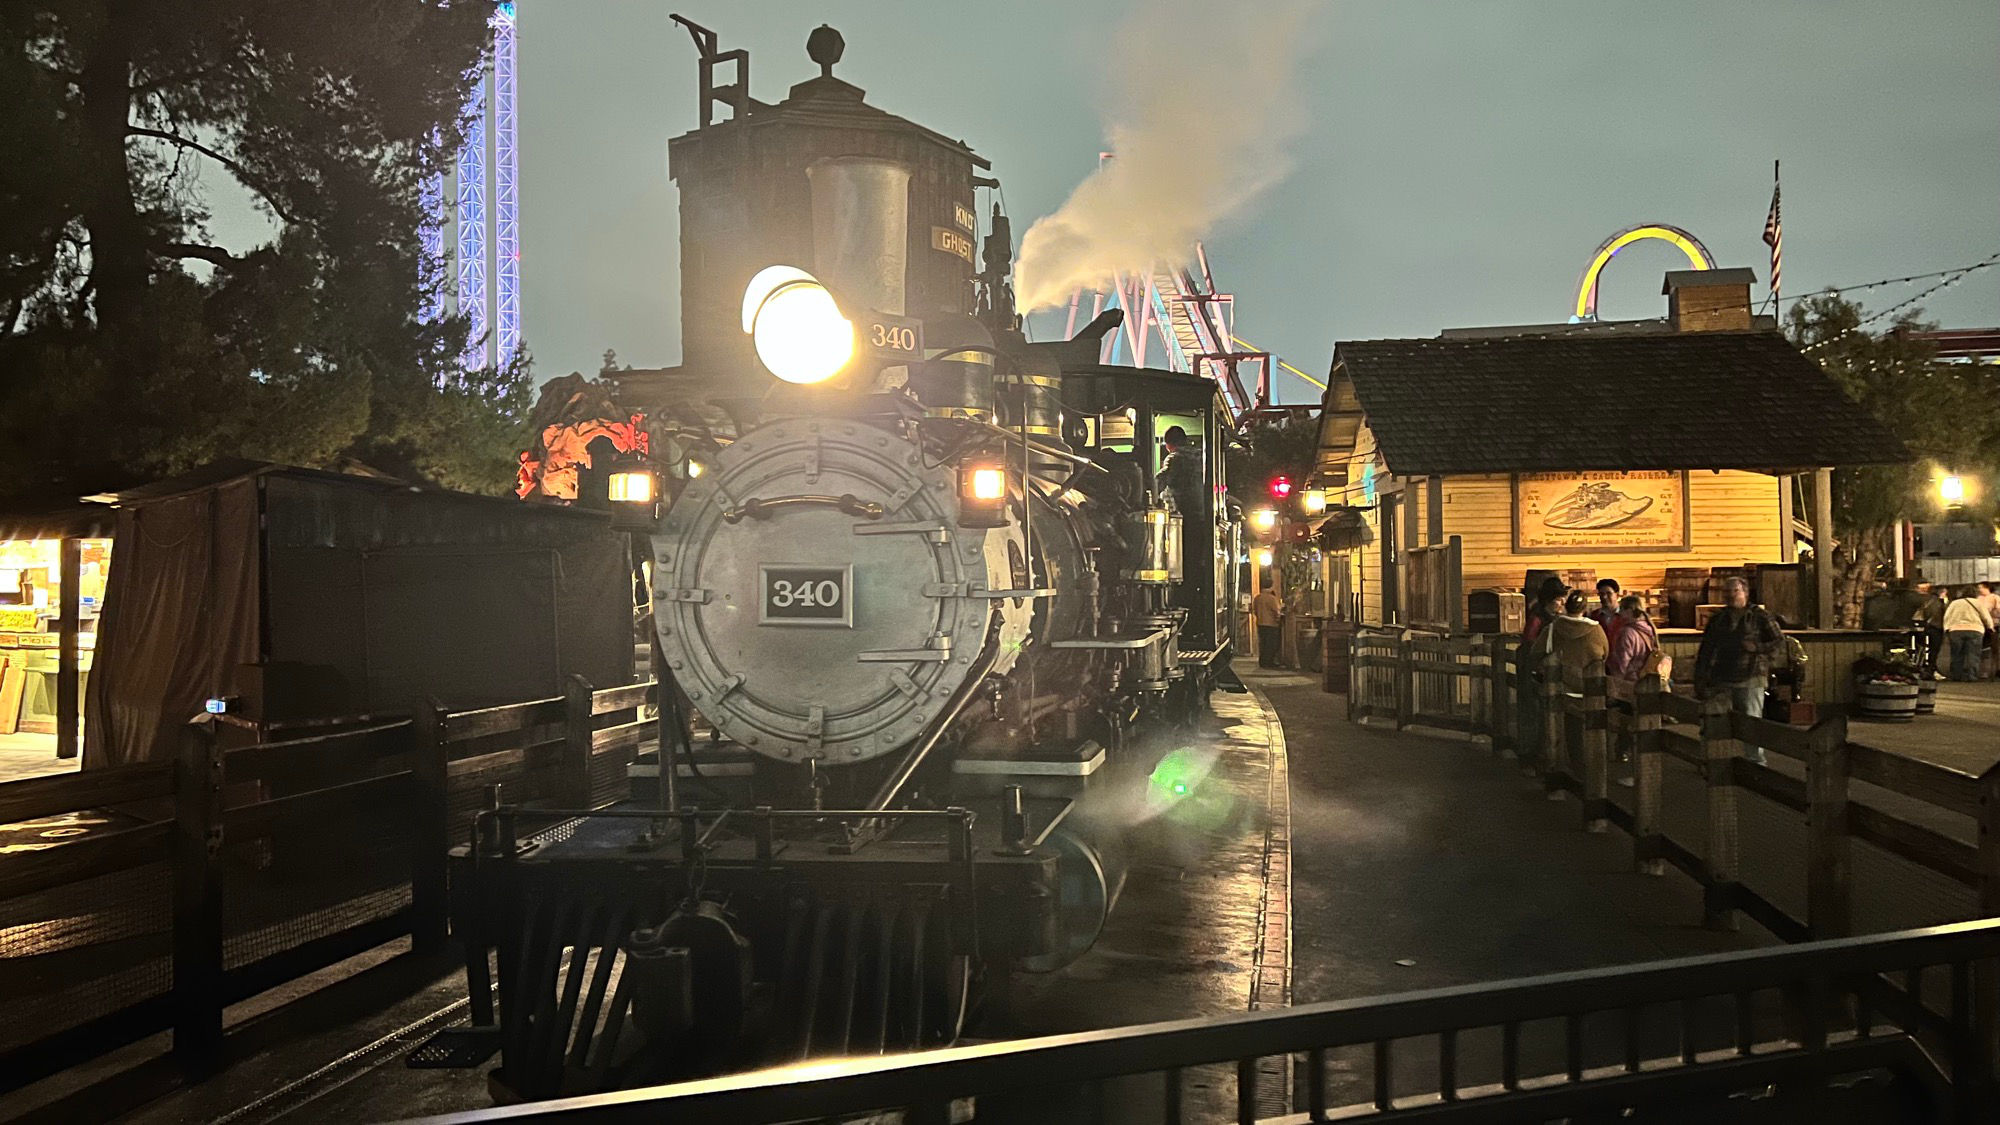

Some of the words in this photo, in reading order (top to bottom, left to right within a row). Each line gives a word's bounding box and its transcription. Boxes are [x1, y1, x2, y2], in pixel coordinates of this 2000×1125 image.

[942, 232, 972, 257] GHOST
[871, 324, 915, 351] 340
[772, 579, 840, 607] 340
